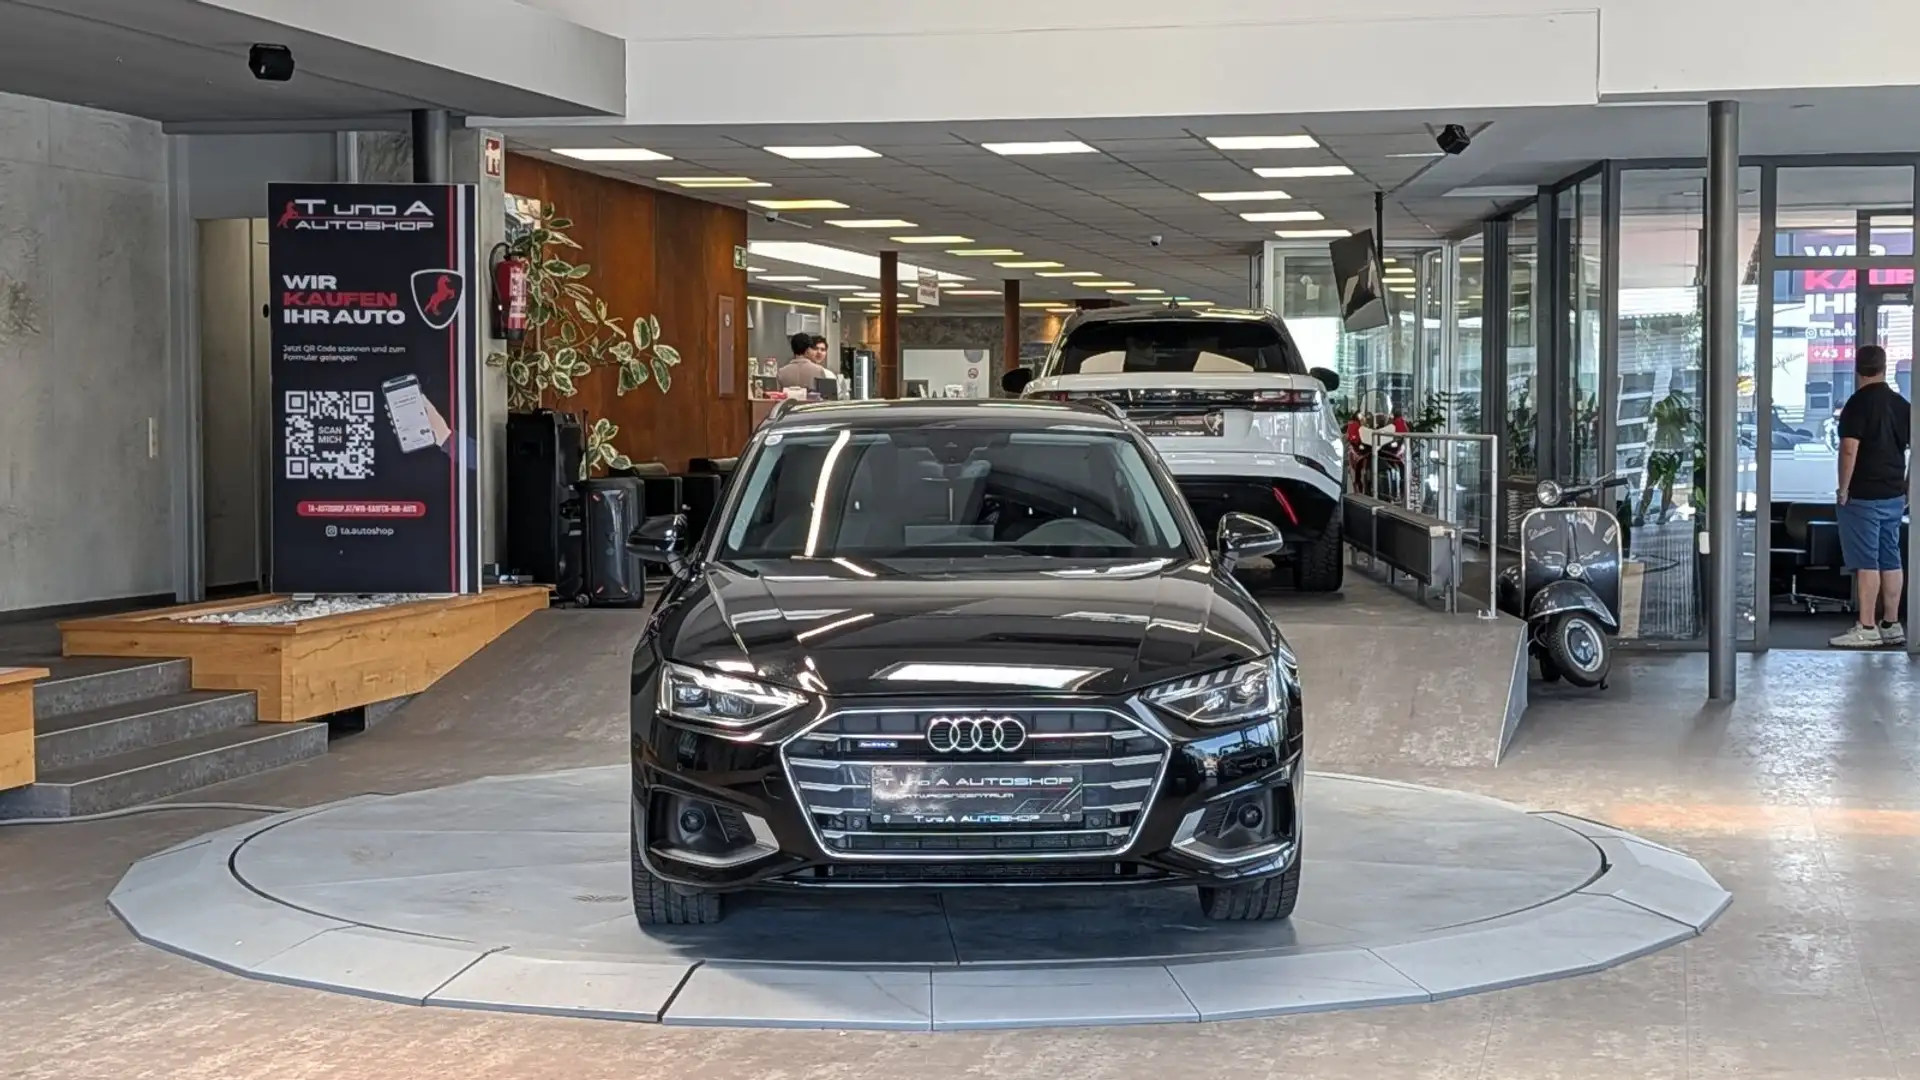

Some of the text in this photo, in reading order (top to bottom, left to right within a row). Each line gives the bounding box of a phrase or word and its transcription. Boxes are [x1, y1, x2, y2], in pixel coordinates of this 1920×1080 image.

[294, 199, 326, 215] T
[403, 200, 435, 216] A
[295, 220, 435, 231] AUTOSHOP
[282, 274, 338, 290] WIR
[283, 292, 398, 307] KAUFEN
[283, 309, 406, 325] IHR AUTO
[283, 345, 302, 353] Jetzt
[303, 345, 316, 354] QR
[316, 345, 337, 353] Code
[371, 346, 388, 354] und
[283, 353, 318, 362] Formular
[317, 426, 343, 435] SCAN
[317, 436, 343, 444] MICH
[340, 526, 395, 537] ta.autoshop
[935, 777, 950, 787] A
[955, 776, 1074, 787] AUTOSHOP
[913, 815, 925, 823] T
[945, 815, 956, 823] A
[960, 814, 1040, 823] AUTOSHOP
